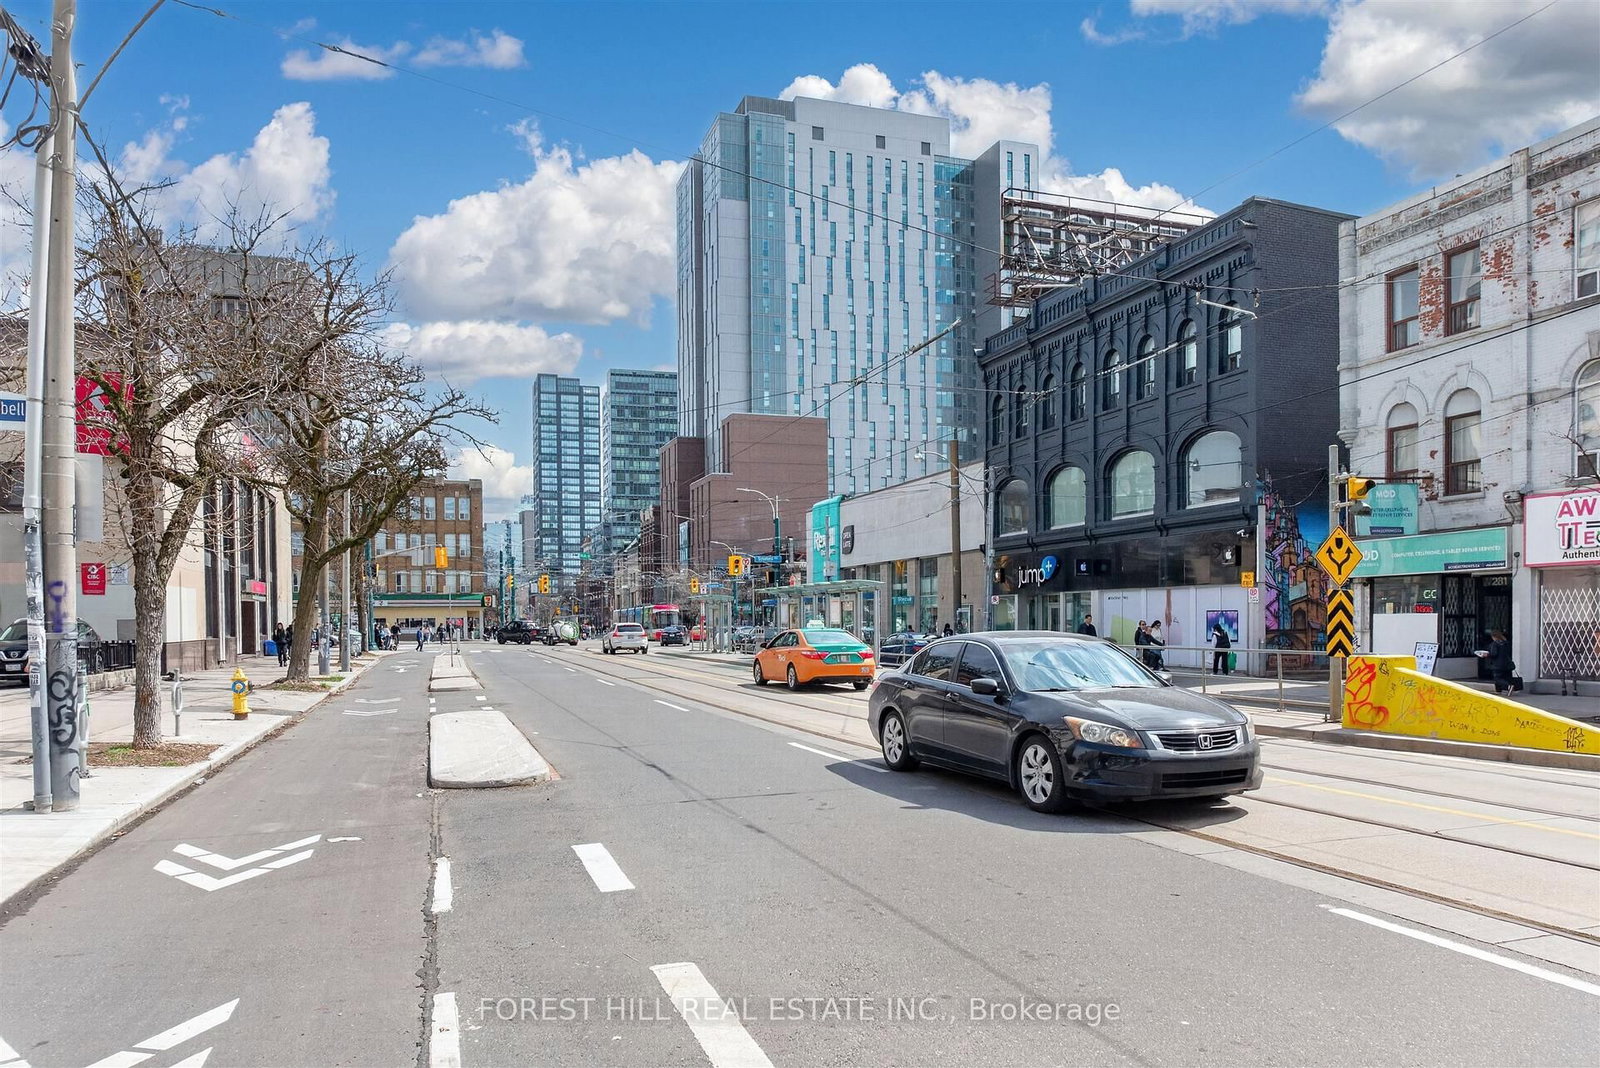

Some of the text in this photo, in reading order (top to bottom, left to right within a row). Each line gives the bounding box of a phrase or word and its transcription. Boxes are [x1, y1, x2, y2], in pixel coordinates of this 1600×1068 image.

[1376, 490, 1396, 498] MOD
[1362, 549, 1379, 561] OD
[1491, 576, 1508, 586] 281
